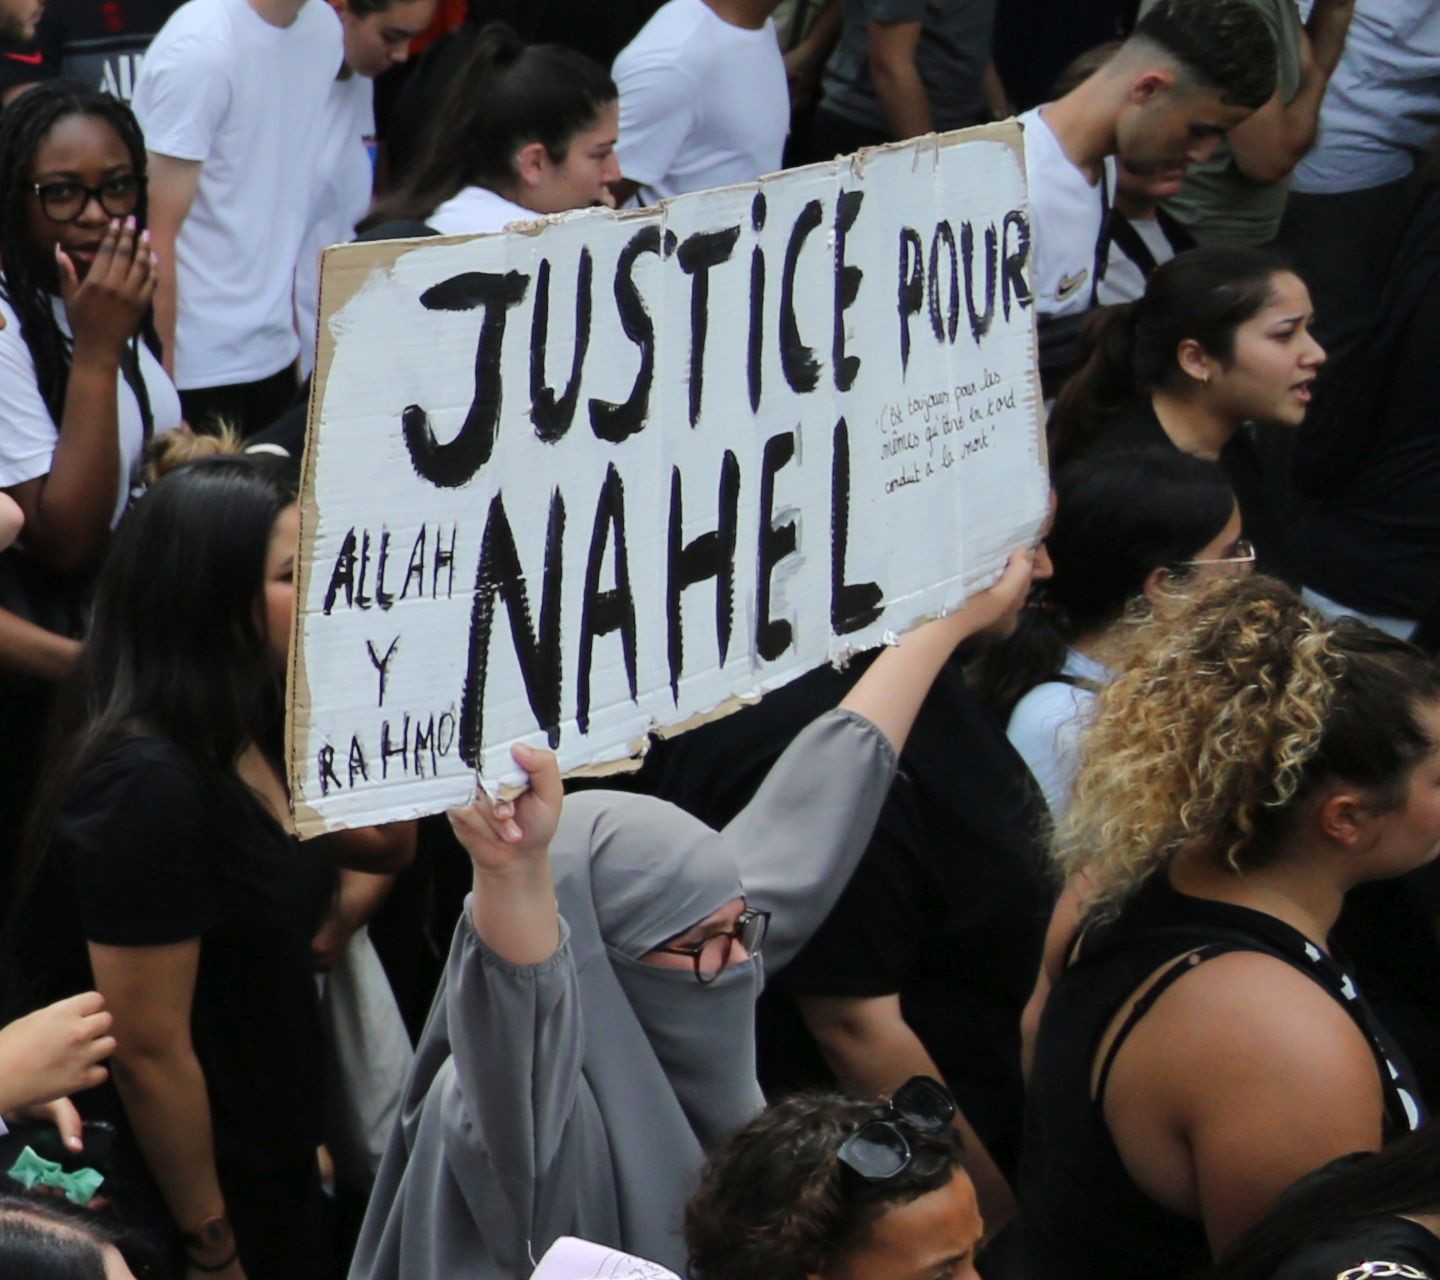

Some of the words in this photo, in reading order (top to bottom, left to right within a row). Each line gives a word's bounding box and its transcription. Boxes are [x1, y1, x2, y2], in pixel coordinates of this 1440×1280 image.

[897, 209, 1036, 384] POUR
[969, 406, 982, 423] en
[980, 368, 1001, 391] les
[322, 521, 458, 616] ALLAH
[460, 417, 884, 770] NAHEL
[366, 634, 400, 707] Y
